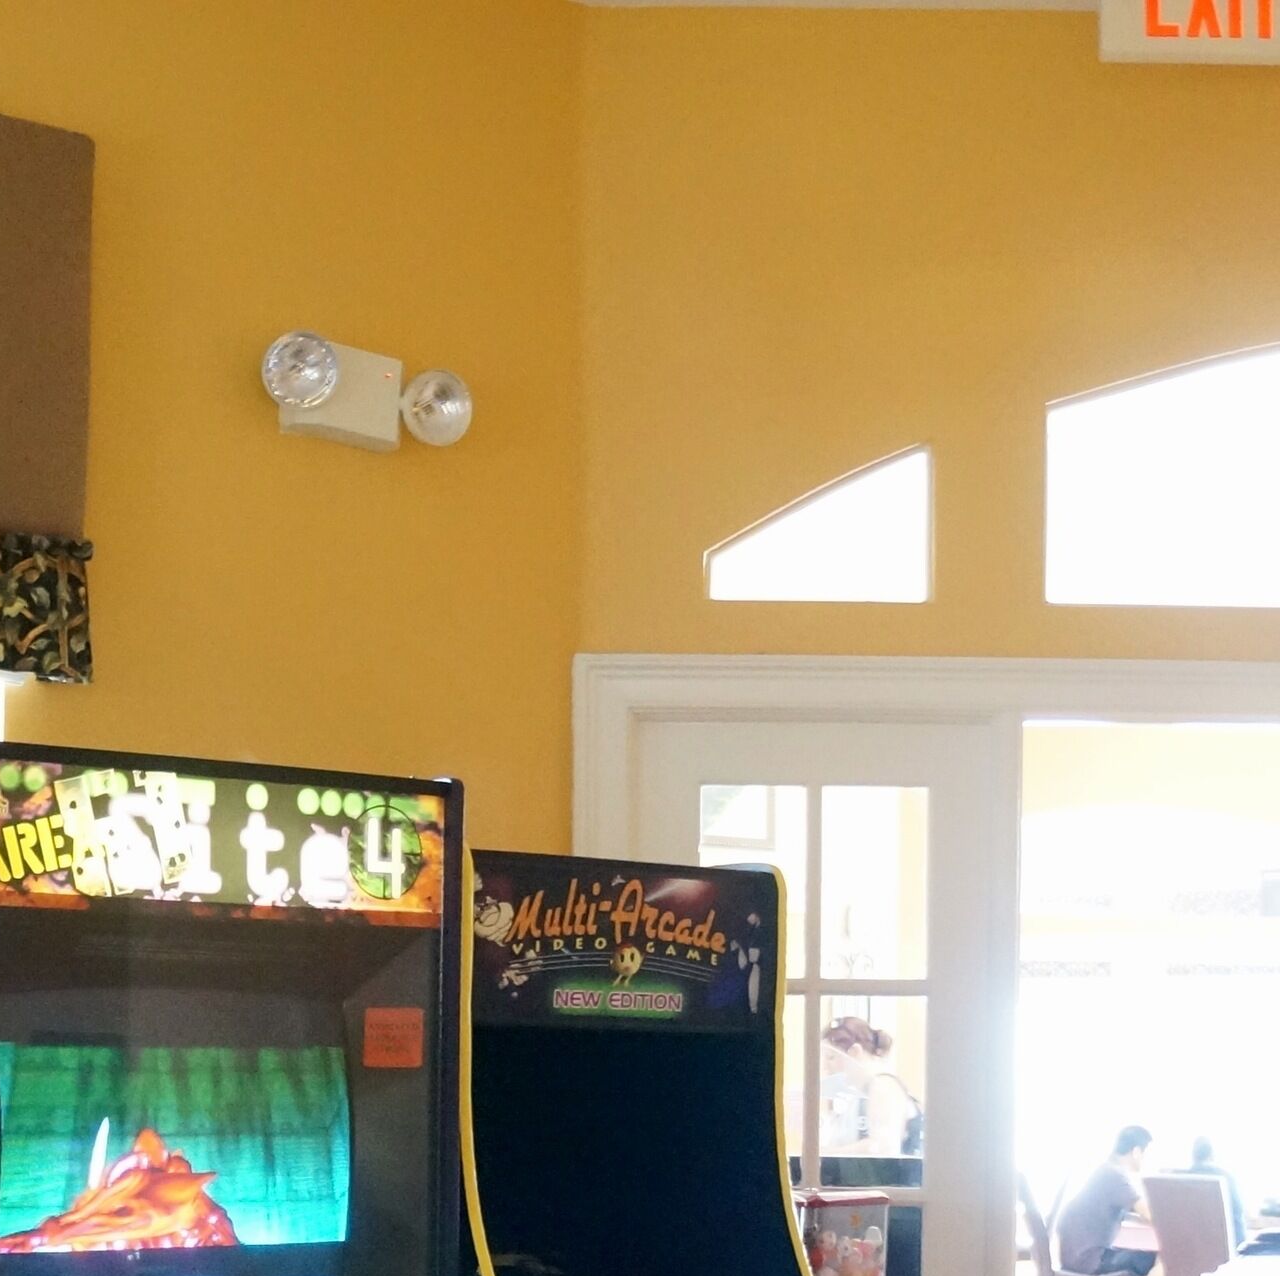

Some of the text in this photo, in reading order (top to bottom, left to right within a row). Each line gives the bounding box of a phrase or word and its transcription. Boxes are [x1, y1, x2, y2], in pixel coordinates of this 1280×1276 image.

[366, 816, 406, 899] 4
[504, 878, 726, 954] Multi-Arcade
[512, 937, 718, 966] VIDEO GAME
[553, 989, 683, 1012] NEW EDITION
